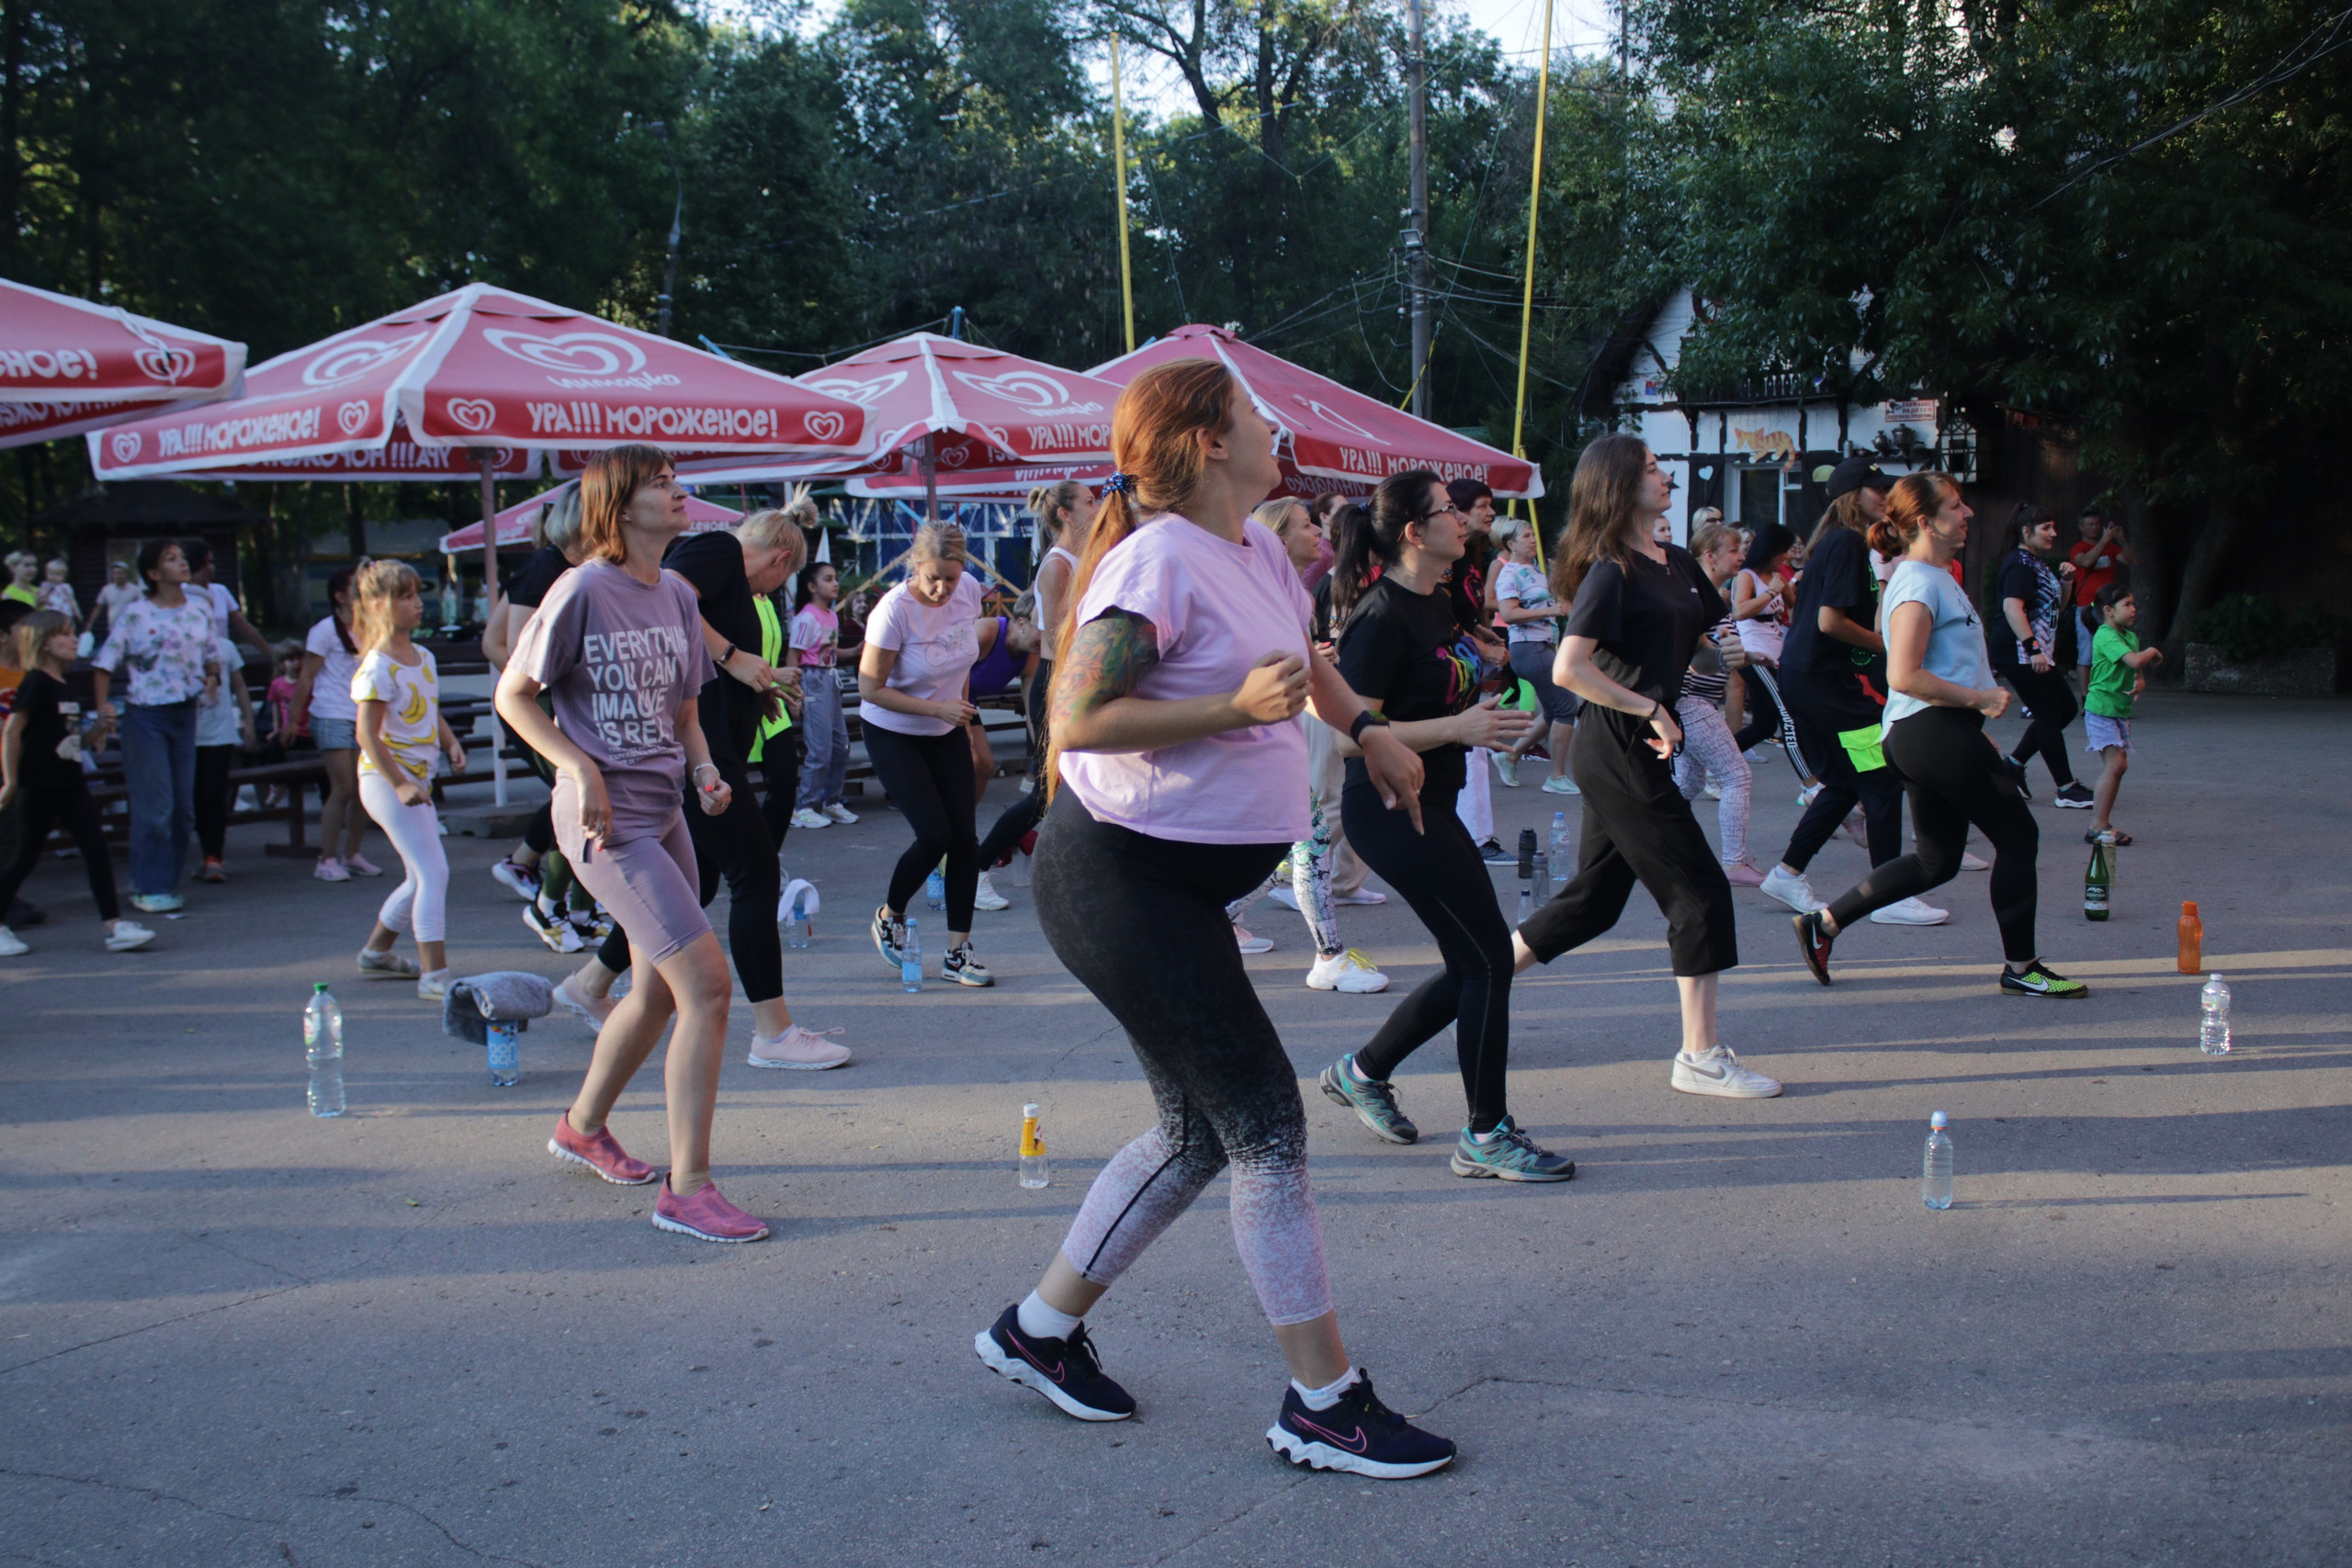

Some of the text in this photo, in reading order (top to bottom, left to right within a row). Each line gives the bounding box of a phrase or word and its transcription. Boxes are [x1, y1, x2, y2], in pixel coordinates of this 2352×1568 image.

[526, 401, 601, 434] УРА!!!
[157, 423, 205, 457] УРА!!!
[1026, 423, 1076, 450] УРА!!!
[1339, 446, 1382, 475] УРА!!!
[586, 656, 677, 692] YOU CAN
[595, 721, 622, 747] IS
